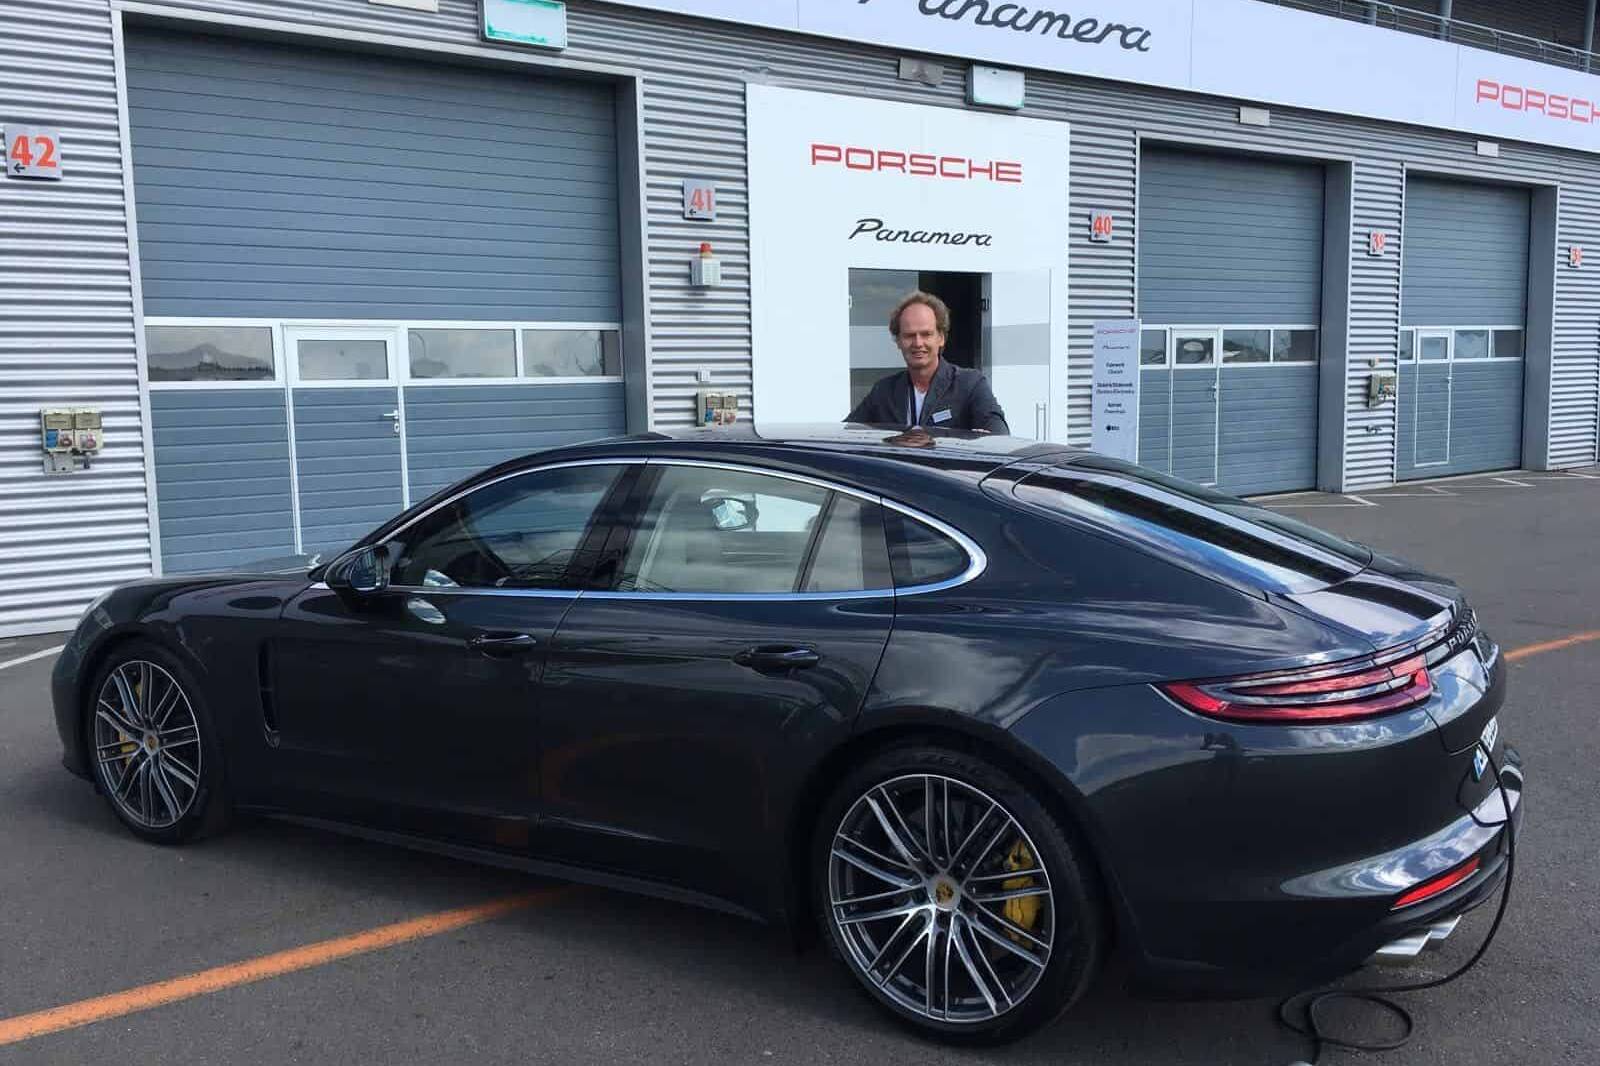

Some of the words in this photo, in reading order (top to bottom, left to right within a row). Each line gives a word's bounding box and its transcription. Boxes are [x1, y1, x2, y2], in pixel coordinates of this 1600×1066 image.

[858, 0, 1152, 51] anamera
[11, 135, 57, 167] 42
[811, 144, 1022, 183] PORSCHE
[690, 189, 712, 212] 41
[848, 217, 993, 247] Panamera
[1093, 216, 1111, 235] 40
